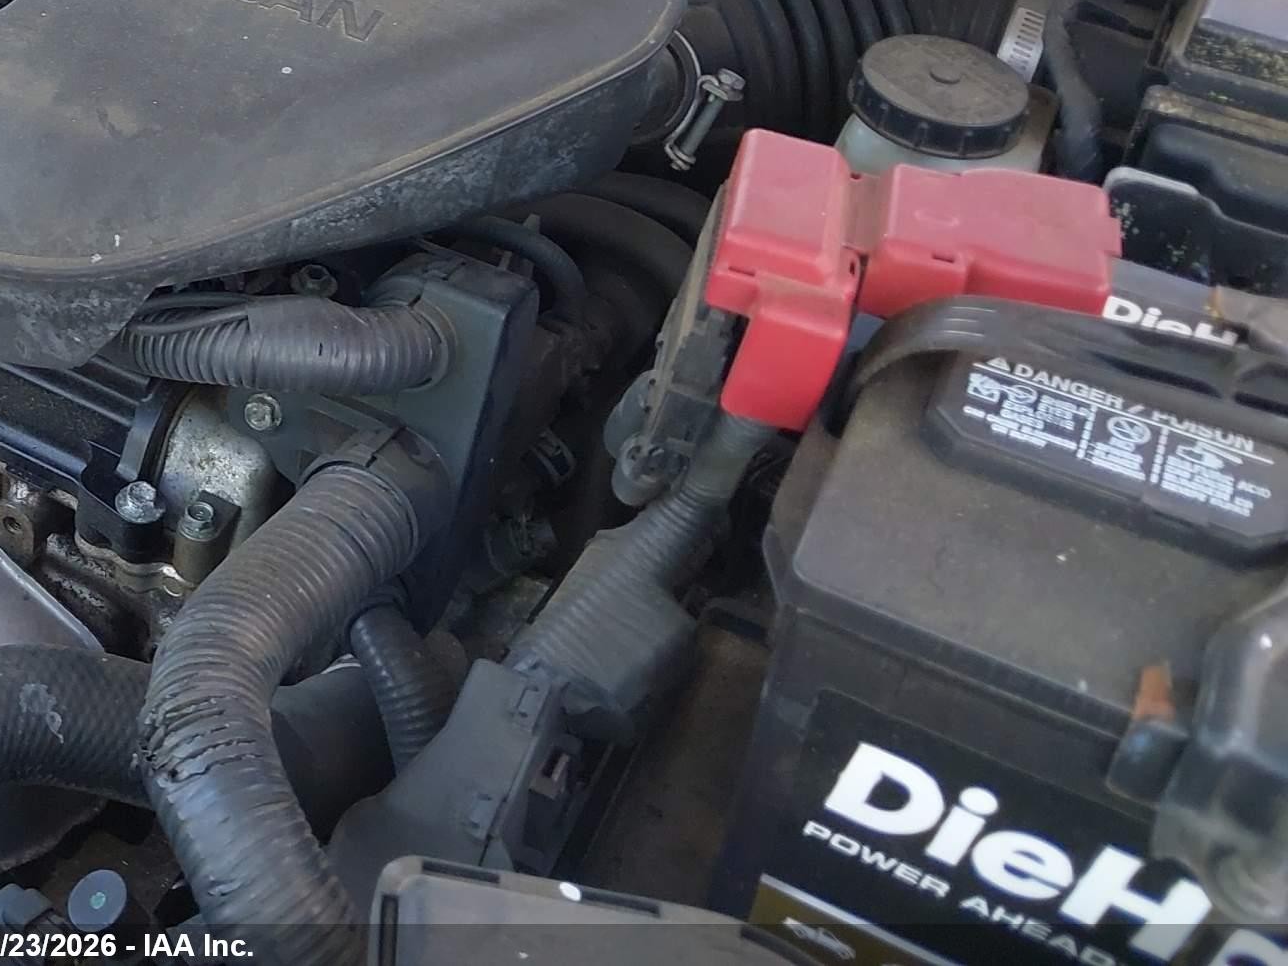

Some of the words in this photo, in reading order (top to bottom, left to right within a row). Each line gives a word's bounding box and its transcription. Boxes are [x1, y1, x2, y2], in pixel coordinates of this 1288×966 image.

[1013, 363, 1126, 410] DANGER
[803, 820, 951, 898] POWER
[960, 895, 1117, 966] AHEAD
